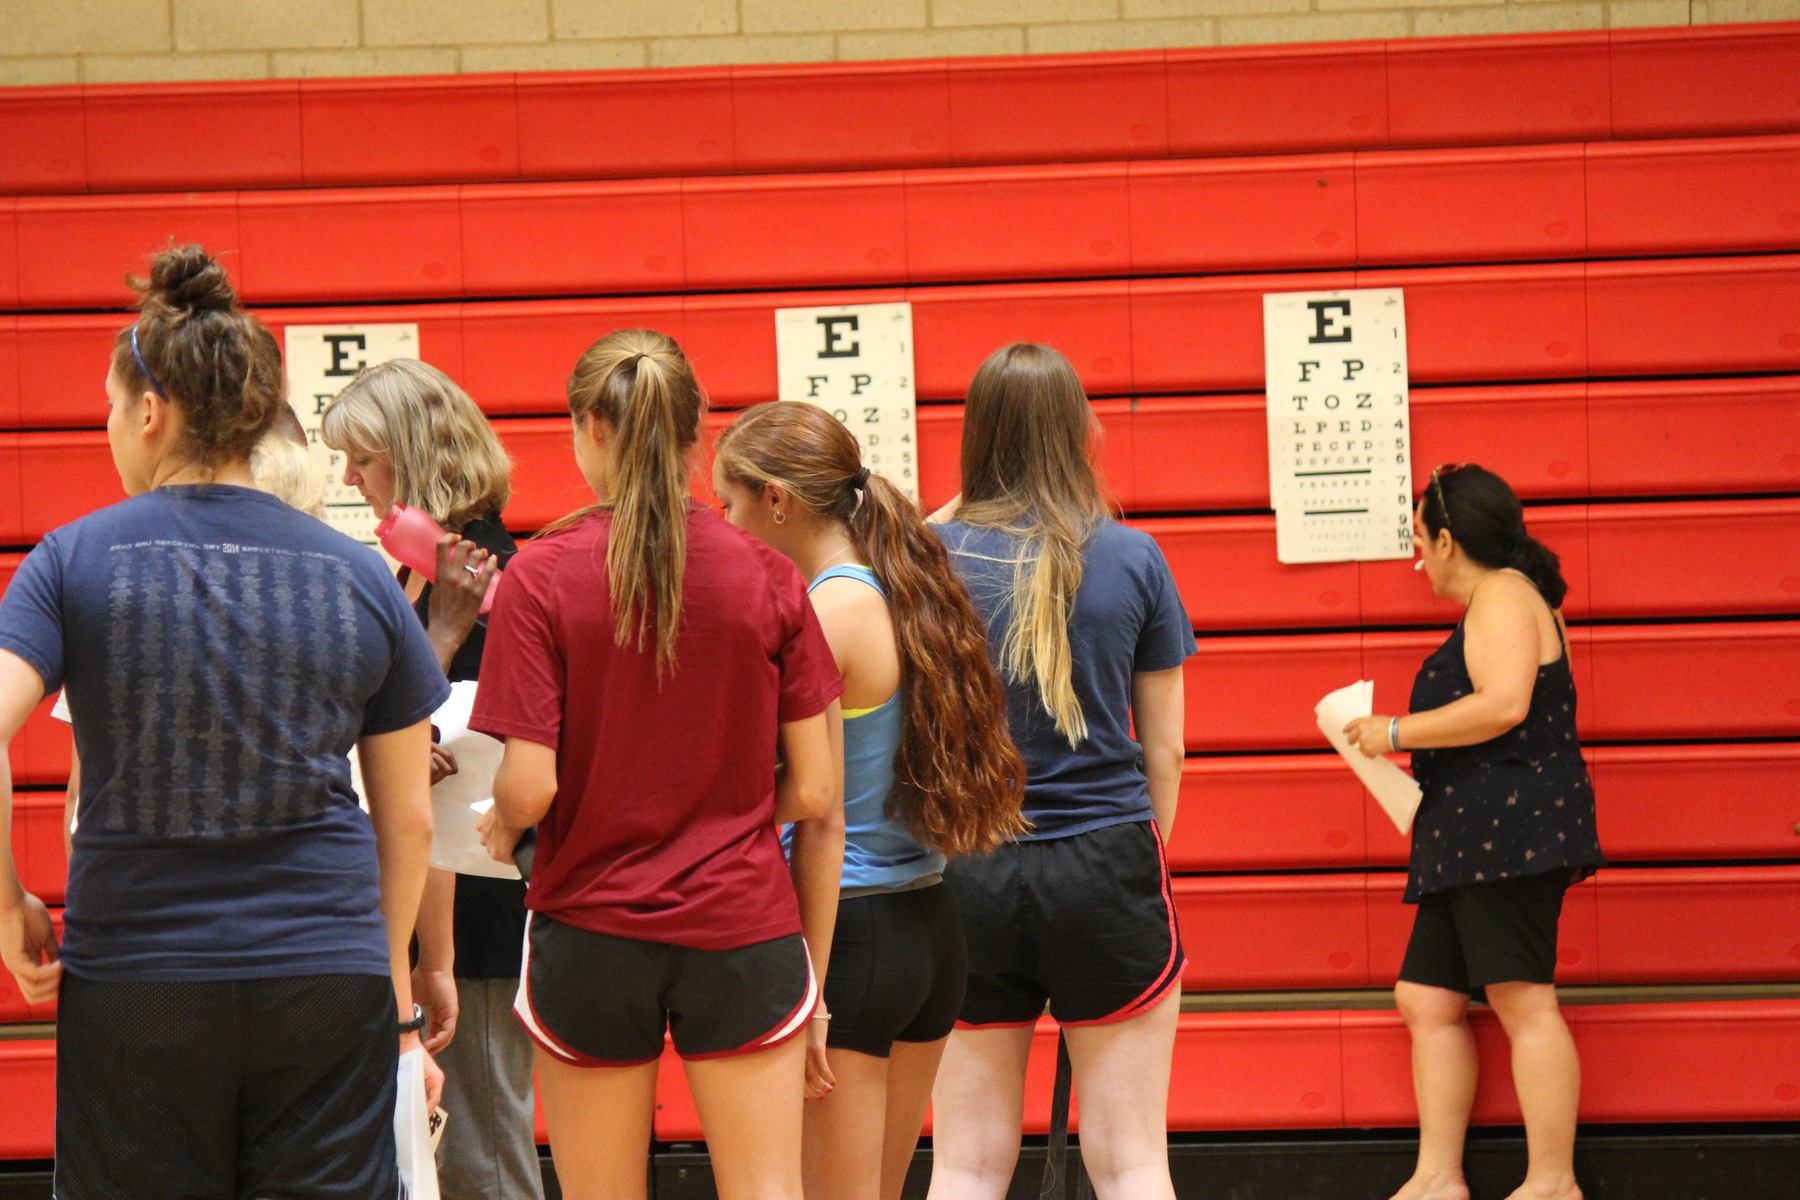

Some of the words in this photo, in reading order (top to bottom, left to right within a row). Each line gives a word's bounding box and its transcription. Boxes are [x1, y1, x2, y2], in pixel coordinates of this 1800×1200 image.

[816, 315, 860, 358] E
[1307, 300, 1352, 343] E
[323, 333, 366, 377] E
[222, 543, 239, 553] 2014
[242, 546, 297, 556] BASKETBALL
